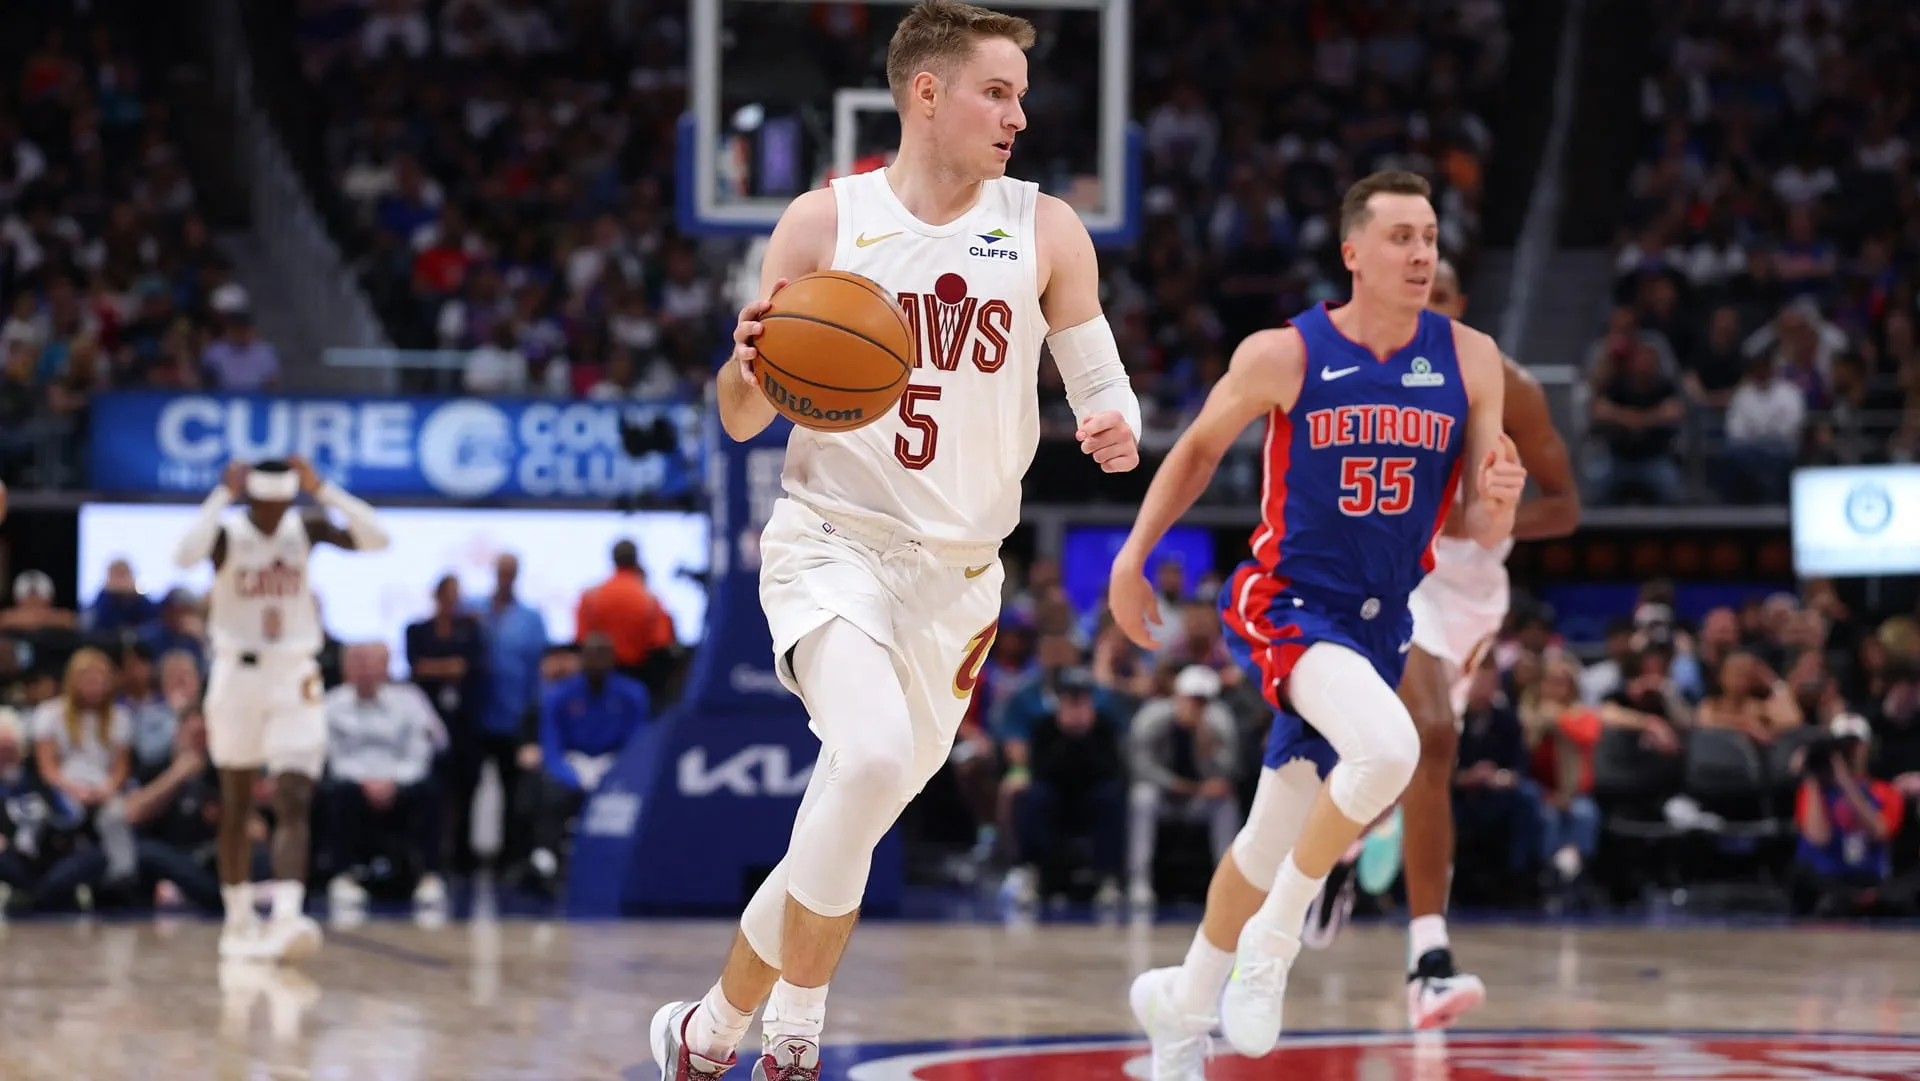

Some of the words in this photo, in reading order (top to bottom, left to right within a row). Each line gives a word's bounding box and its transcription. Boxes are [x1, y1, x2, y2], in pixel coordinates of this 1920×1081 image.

[968, 246, 1018, 261] CLIFFS
[897, 291, 1012, 374] AVS
[764, 371, 863, 421] Wilson
[157, 396, 414, 469] CURE
[894, 383, 942, 471] 5
[1306, 404, 1455, 452] DETROIT
[1338, 456, 1417, 516] 55
